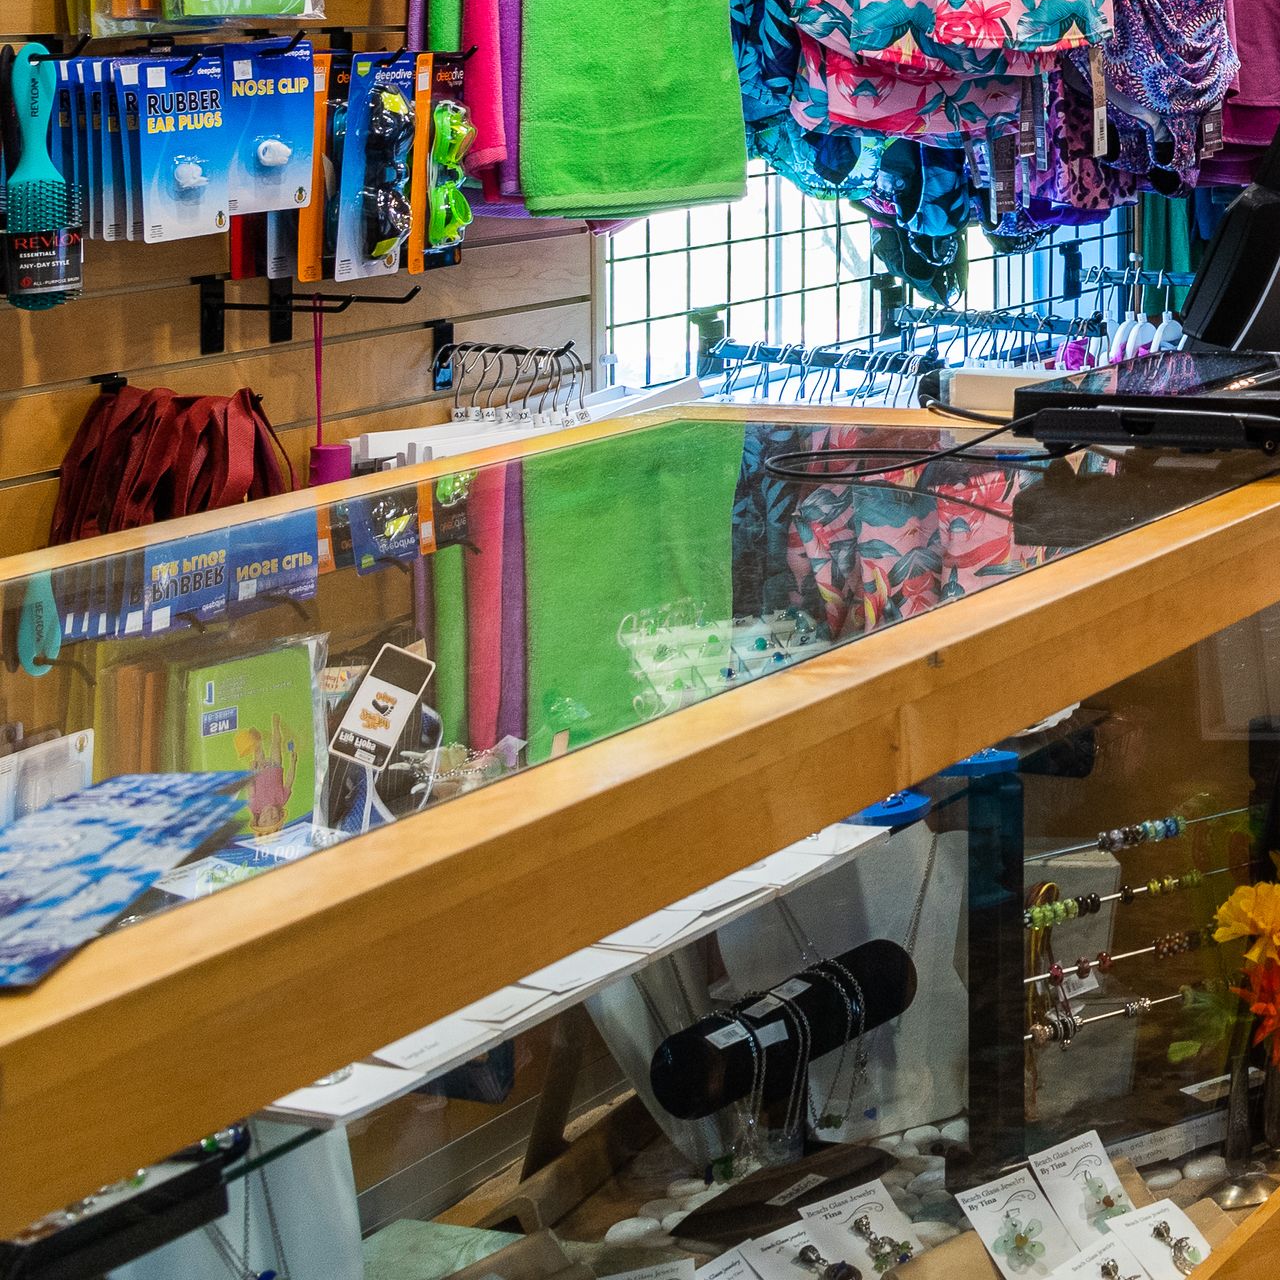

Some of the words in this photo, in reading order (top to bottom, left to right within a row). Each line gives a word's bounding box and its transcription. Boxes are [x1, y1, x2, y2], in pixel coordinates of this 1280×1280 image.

[375, 69, 412, 81] deepdive
[232, 79, 275, 96] NOSE
[278, 77, 309, 94] CLIP
[30, 78, 39, 118] REVLON
[147, 89, 221, 116] RUBBER
[147, 118, 176, 134] EAR
[178, 112, 222, 130] PLUGS
[15, 233, 82, 250] REVLON
[20, 261, 49, 269] ANY-DAY
[51, 259, 70, 267] STYLE
[1034, 1156, 1053, 1168] Beach
[1053, 1148, 1070, 1161] Glass
[1070, 1140, 1093, 1153] Jewelry
[1040, 1167, 1050, 1175] By
[1050, 1161, 1067, 1171] Tina
[961, 1193, 982, 1205] Beach
[982, 1187, 999, 1200] Glass
[1000, 1175, 1025, 1190] Jewelry
[806, 1206, 828, 1218] Beach
[829, 1200, 848, 1210] Glass
[849, 1187, 876, 1202] Jewelry
[968, 1204, 979, 1212] By
[980, 1198, 997, 1208] Tina
[822, 1210, 842, 1220] Tina
